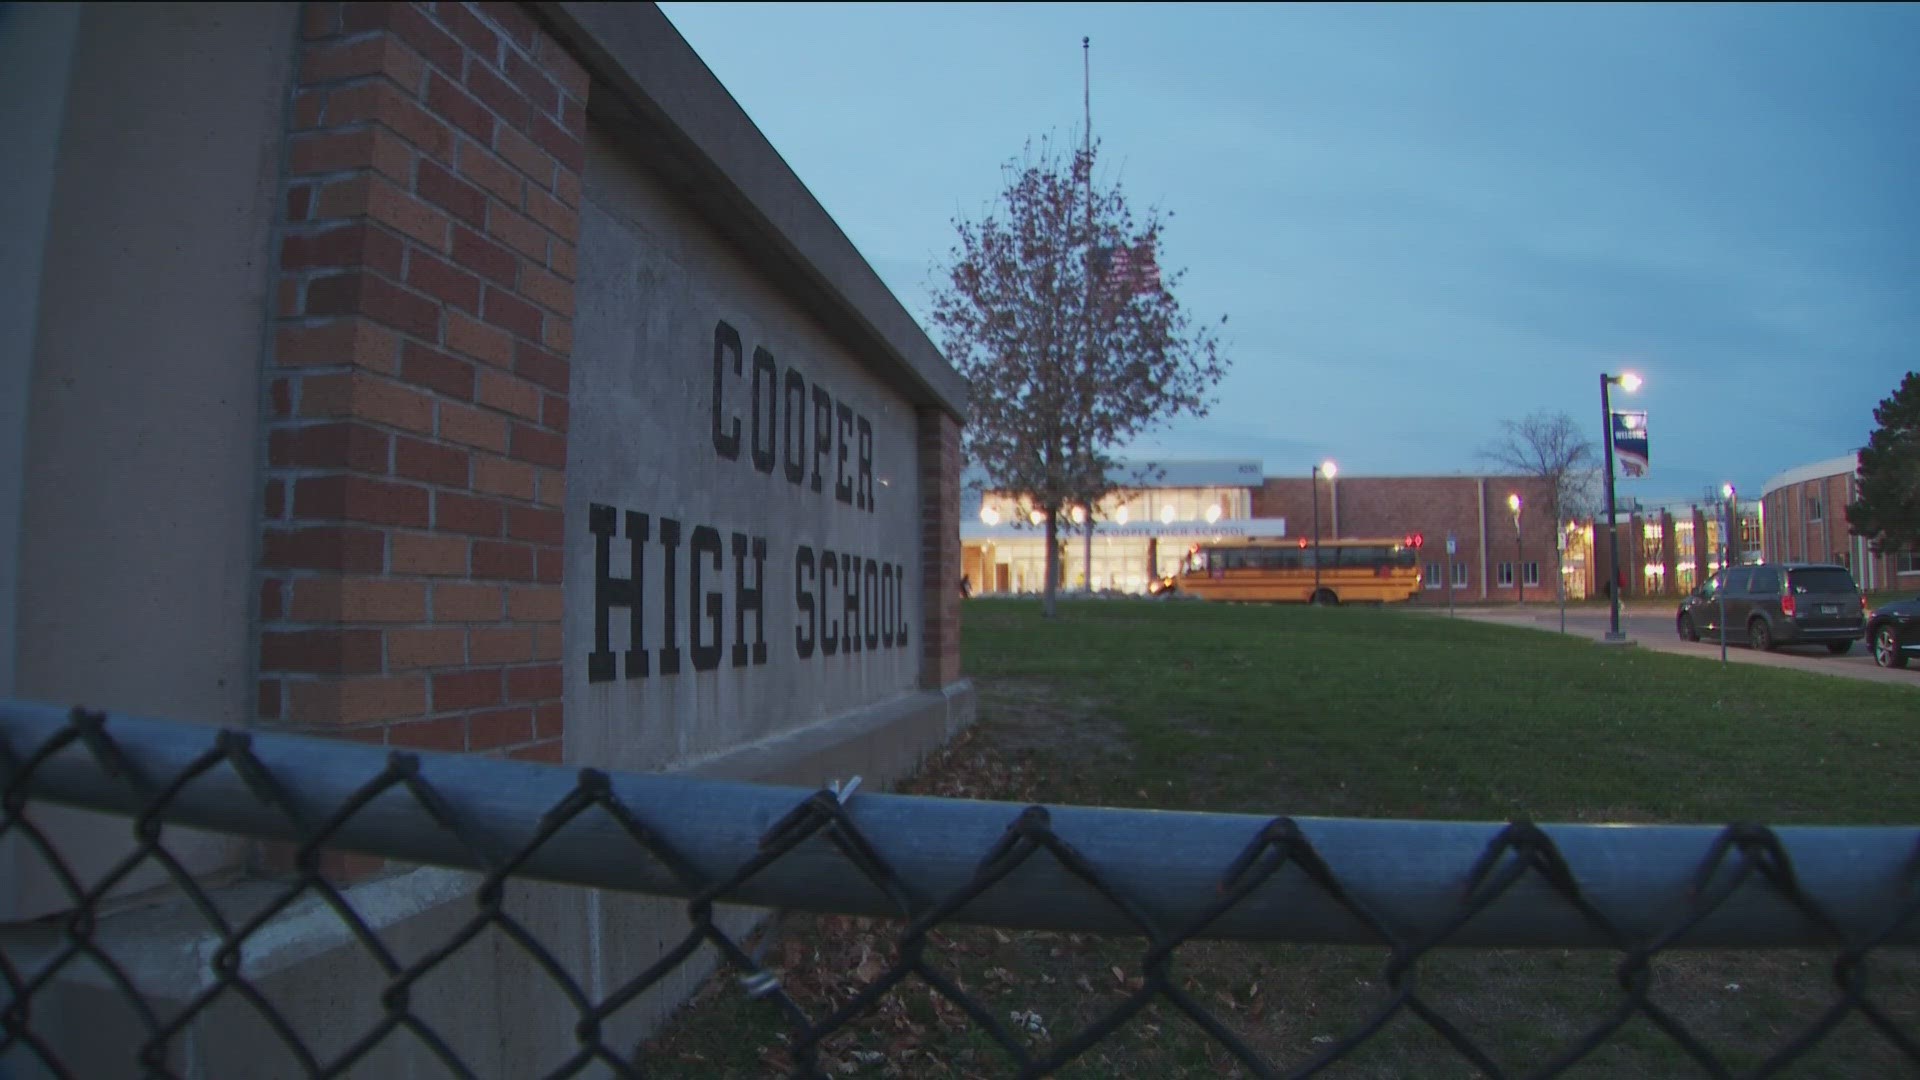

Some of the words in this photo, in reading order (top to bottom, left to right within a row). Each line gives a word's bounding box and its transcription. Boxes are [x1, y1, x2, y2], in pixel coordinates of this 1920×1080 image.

[712, 318, 875, 513] COOPER
[588, 502, 768, 683] HIGH
[795, 545, 909, 660] SCHOOL
[1156, 527, 1188, 536] HIGH
[1195, 527, 1246, 536] SCHOOL
